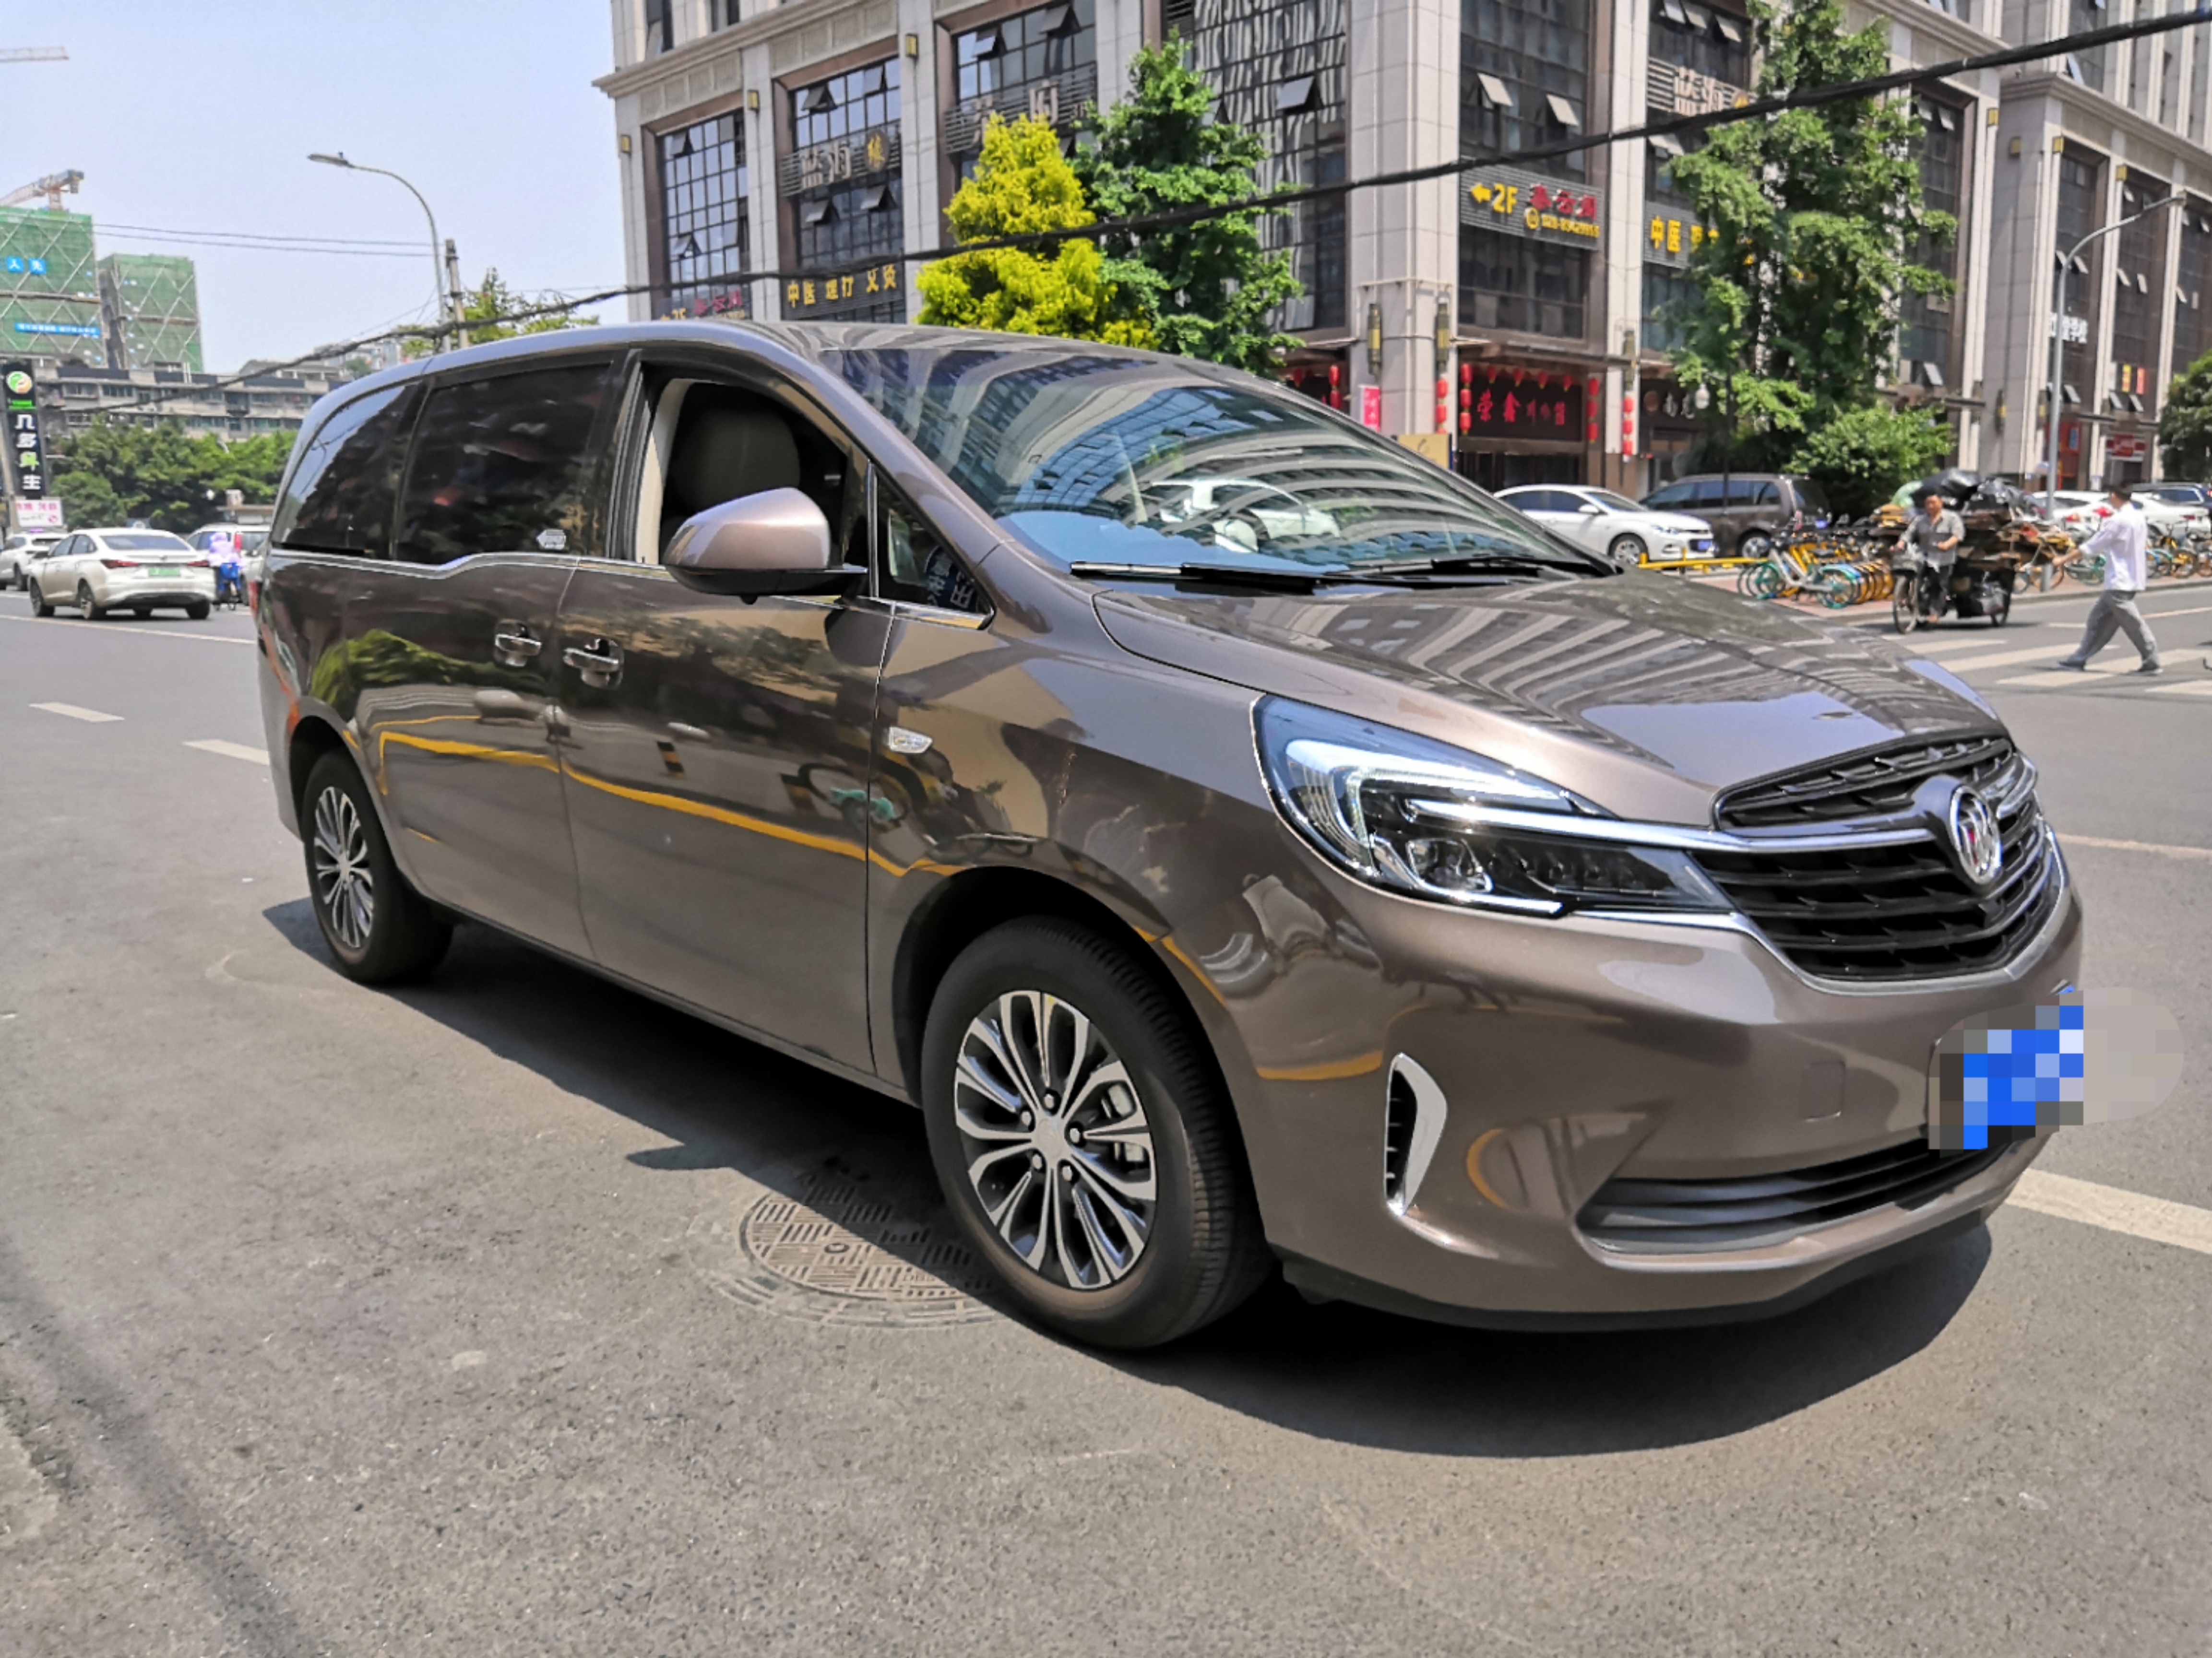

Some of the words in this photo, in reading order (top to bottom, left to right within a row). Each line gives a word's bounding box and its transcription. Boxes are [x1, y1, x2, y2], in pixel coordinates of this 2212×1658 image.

[1492, 183, 1518, 214] 2F
[1651, 215, 1681, 252] 中医
[787, 279, 816, 308] 中医
